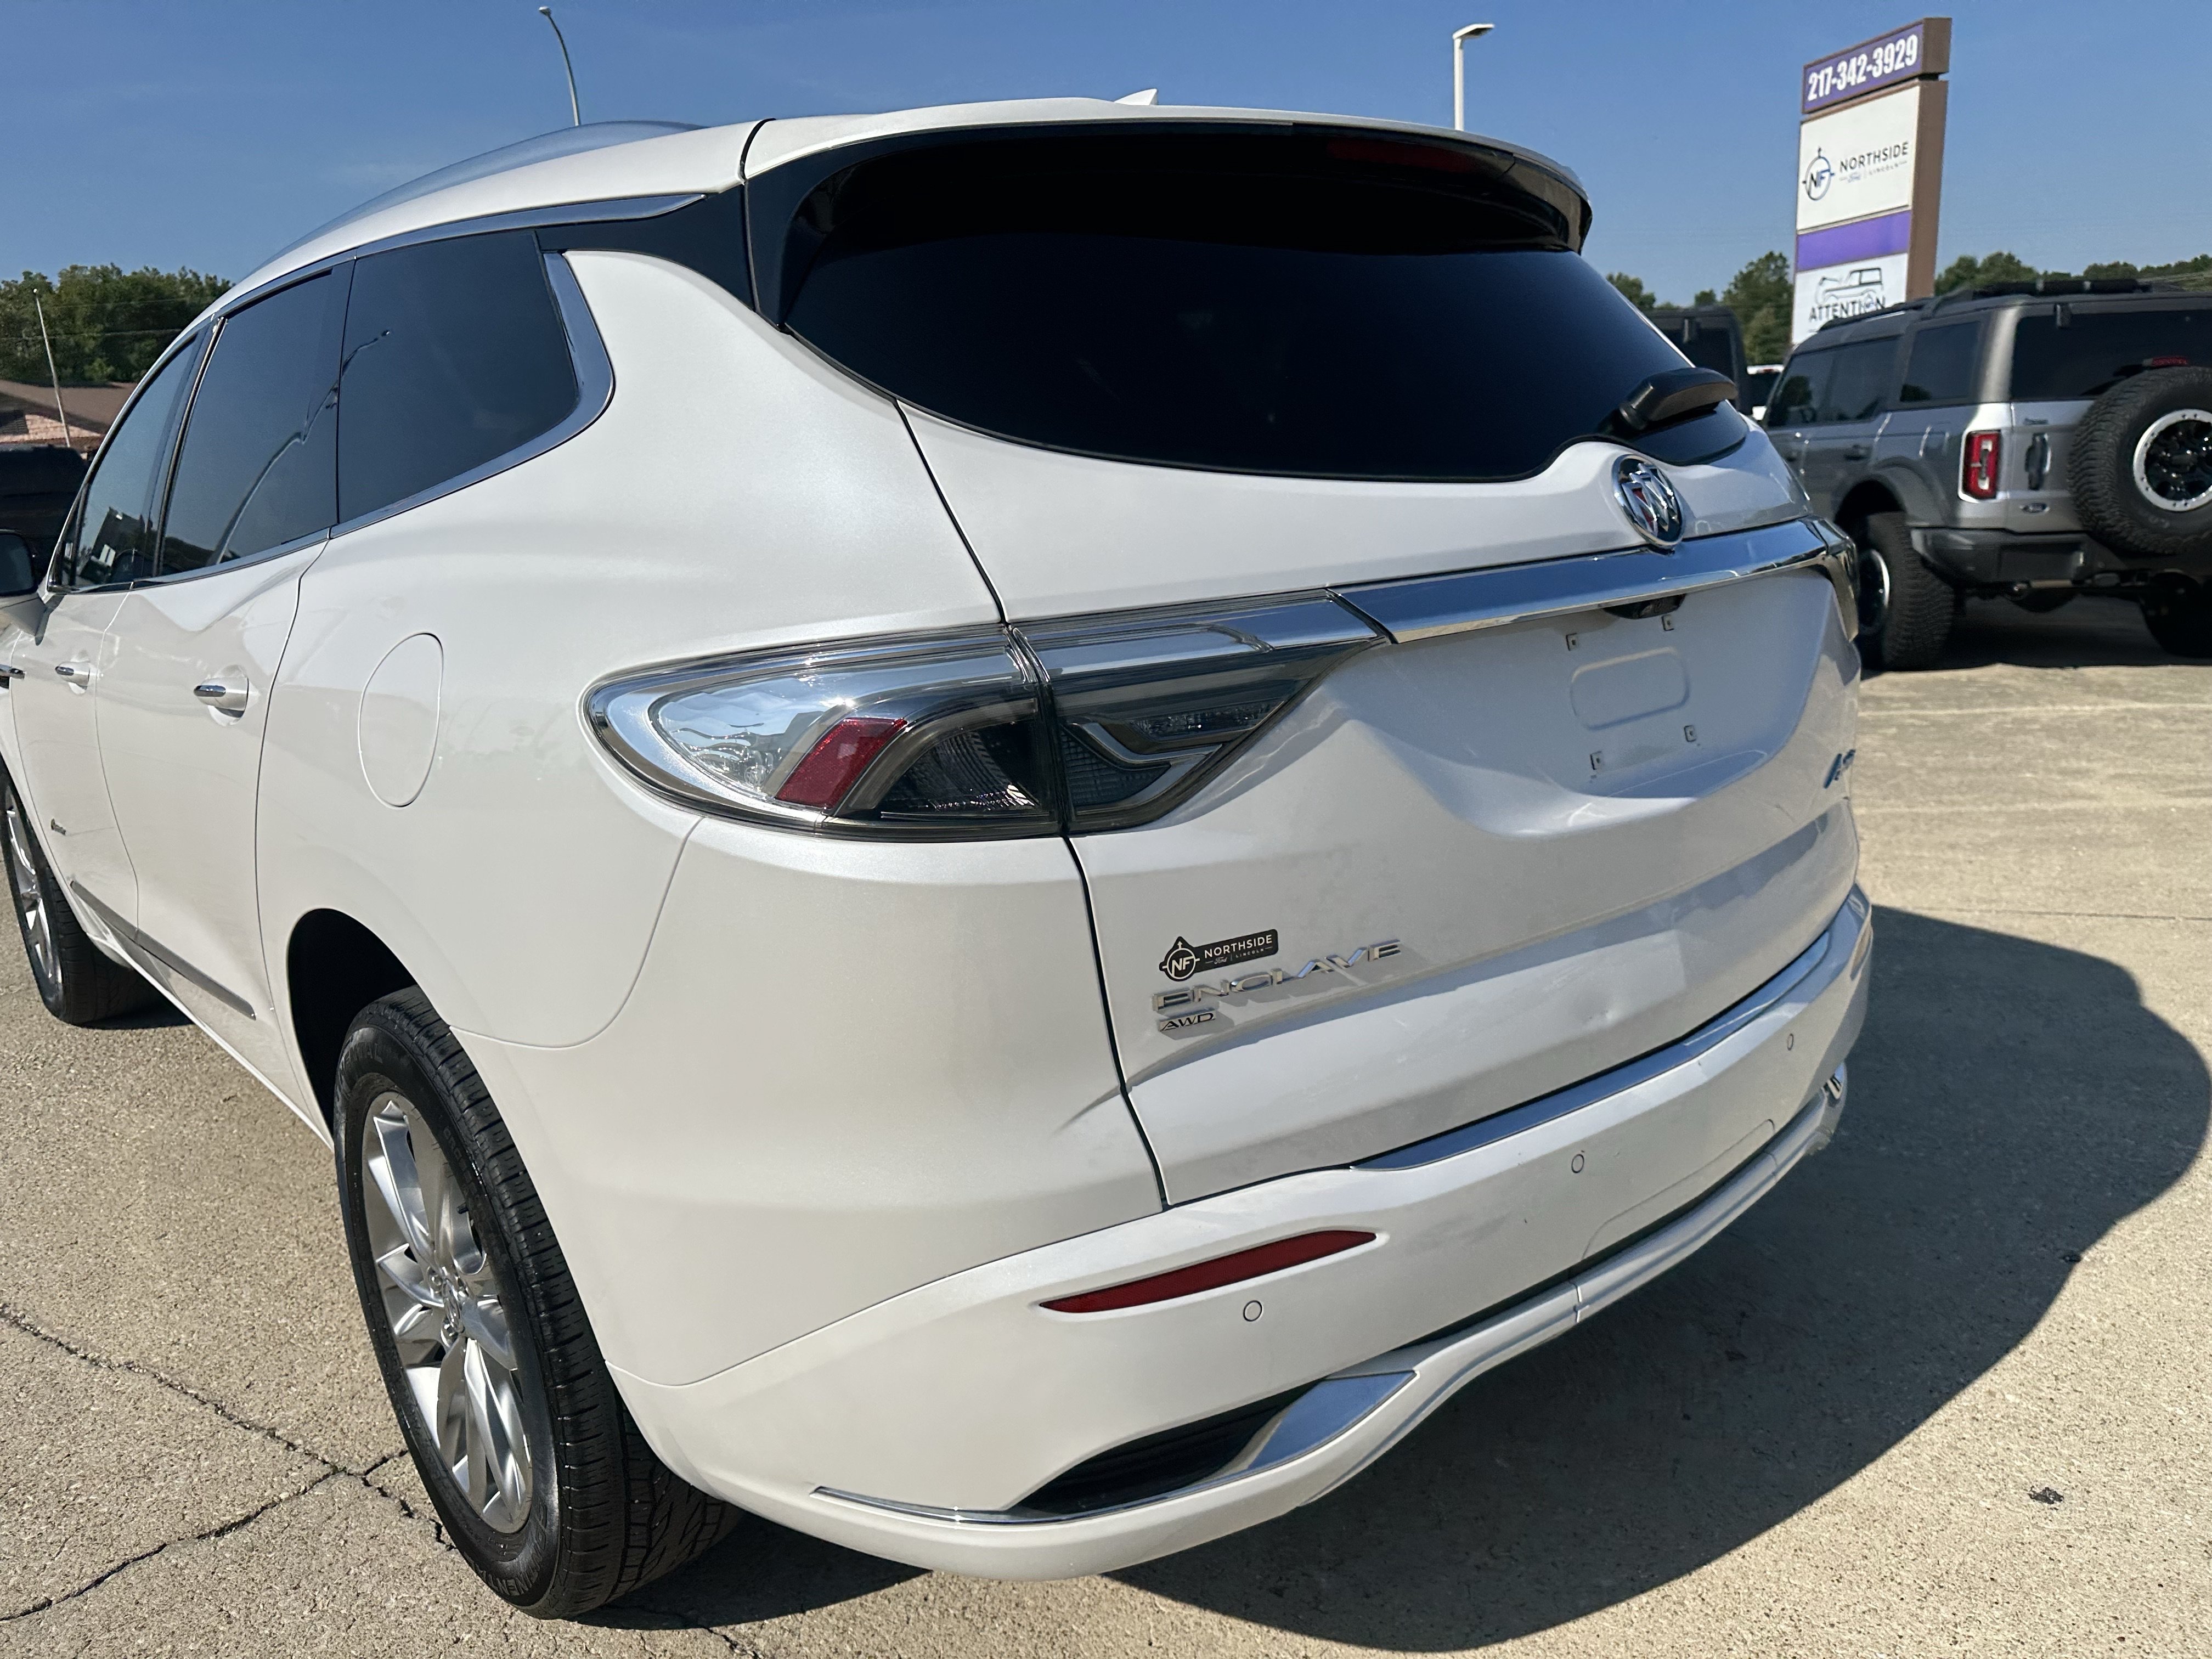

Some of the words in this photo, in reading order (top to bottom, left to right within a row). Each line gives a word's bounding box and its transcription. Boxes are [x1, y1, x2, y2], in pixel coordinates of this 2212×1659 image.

[1807, 33, 1918, 101] 217-342-3929
[1839, 141, 1909, 173] NORTHSIDE
[1204, 934, 1273, 959] NORTHSIDE
[1214, 956, 1228, 964] Ford
[1235, 948, 1264, 958] LINCOLN
[1153, 939, 1401, 1012] ENCLAVE
[1161, 1012, 1214, 1031] AWD
